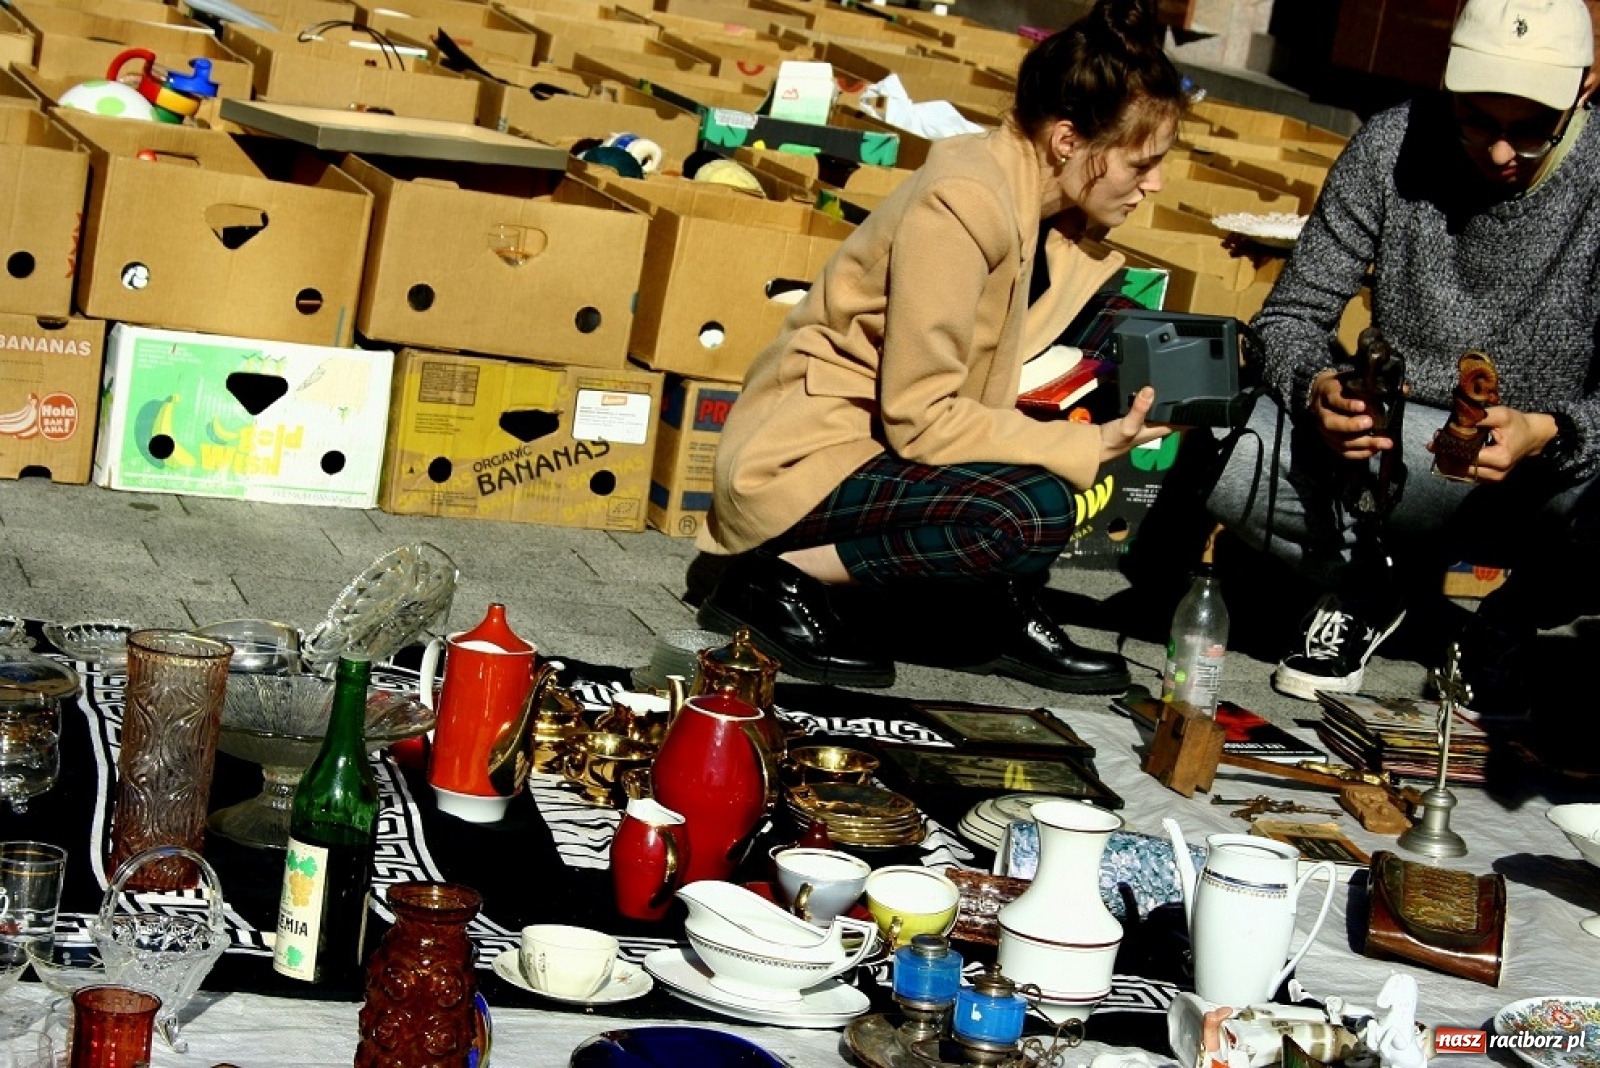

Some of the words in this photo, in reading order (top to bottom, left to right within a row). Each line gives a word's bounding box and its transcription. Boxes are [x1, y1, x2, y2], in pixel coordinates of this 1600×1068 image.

[698, 397, 735, 426] PR
[473, 446, 532, 472] ORGANIC
[476, 439, 611, 496] BANANAS
